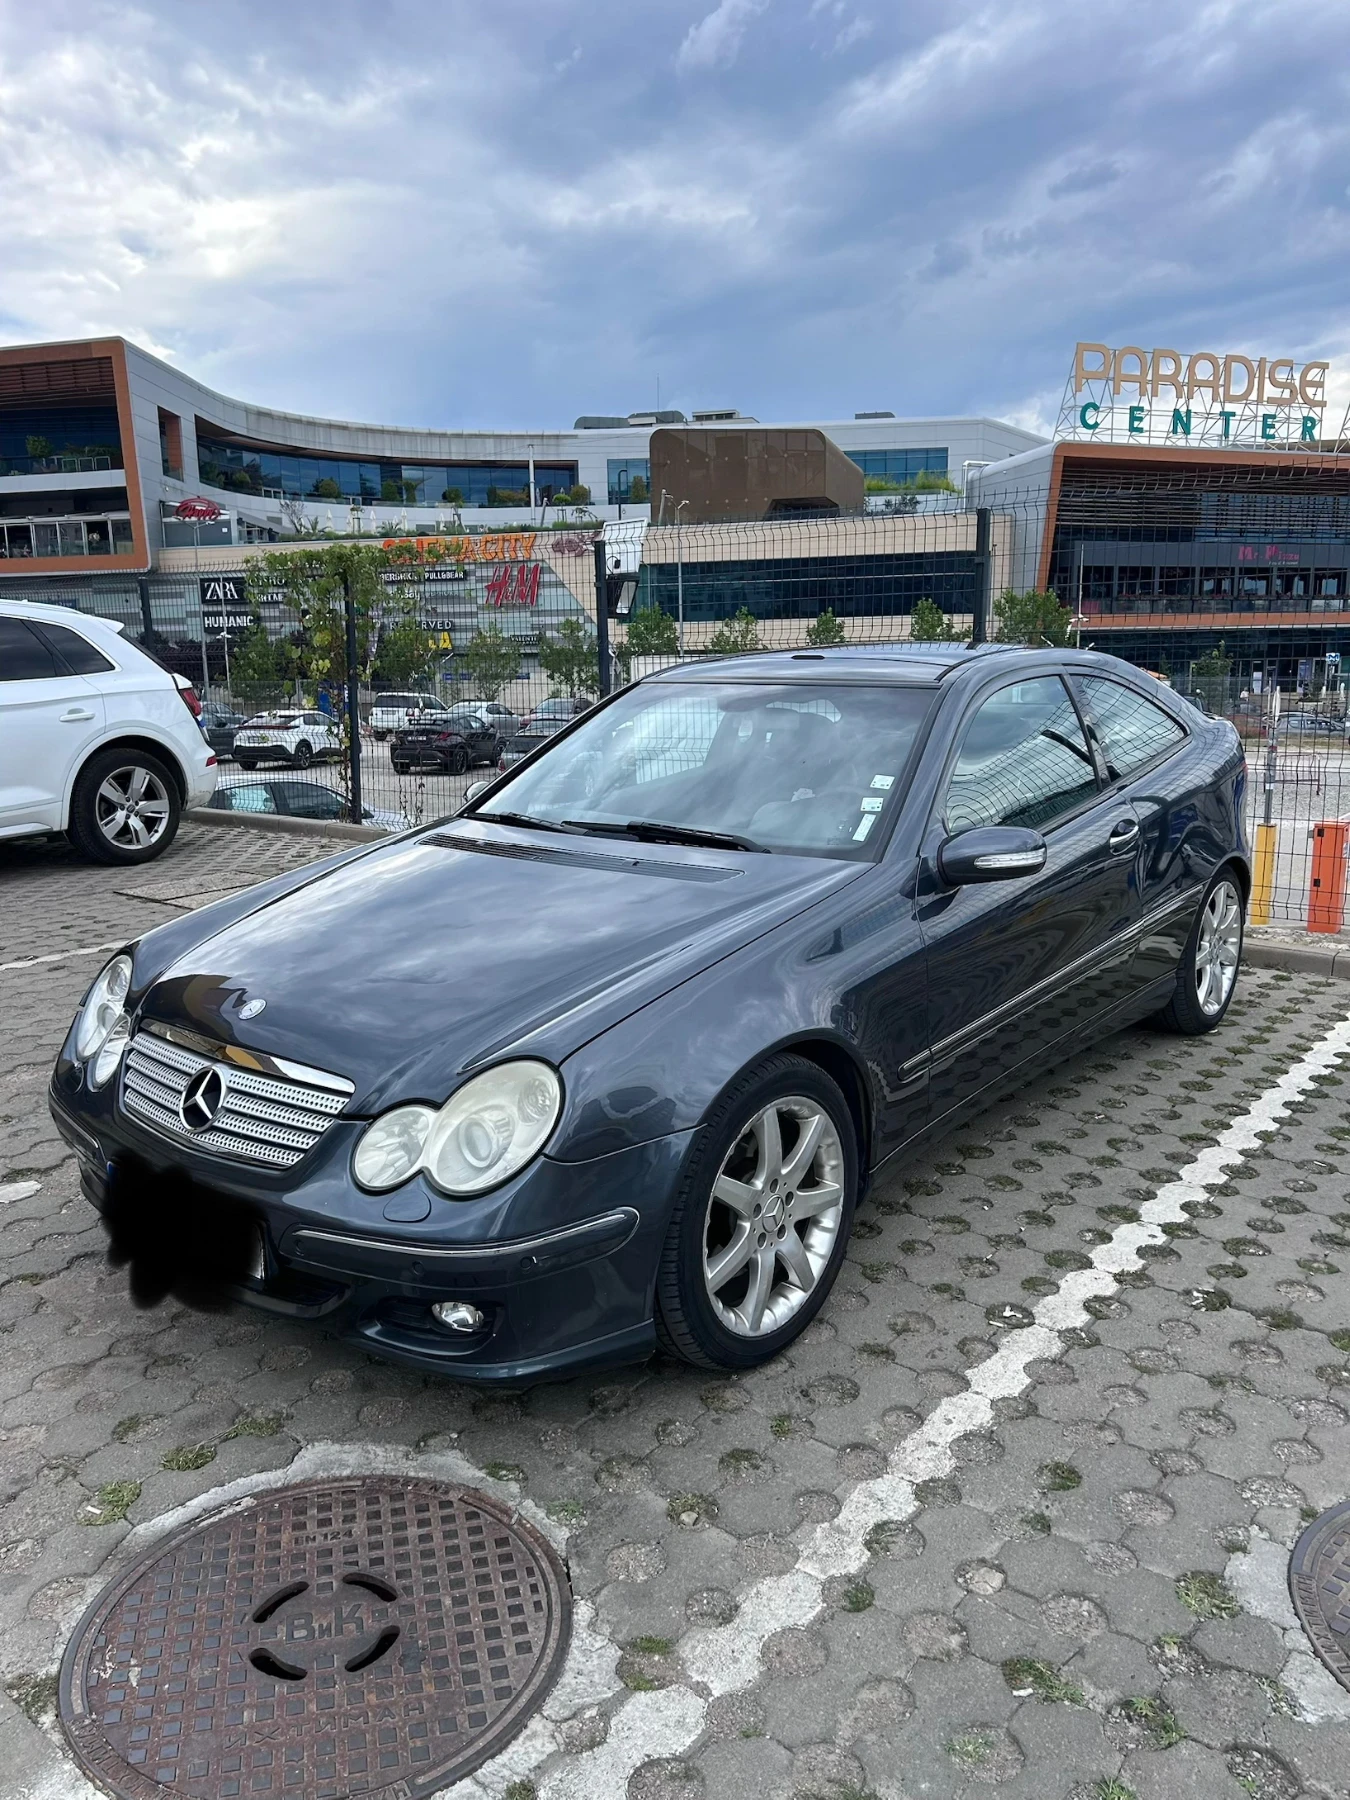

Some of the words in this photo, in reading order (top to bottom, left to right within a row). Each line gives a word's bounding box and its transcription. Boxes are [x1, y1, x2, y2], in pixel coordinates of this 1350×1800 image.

[1075, 342, 1330, 408] PARADISE
[1079, 401, 1317, 442] CENTER
[480, 533, 537, 560] CITY
[424, 571, 464, 580] PULL&BEAR
[484, 563, 540, 607] H&M
[204, 581, 239, 600] ZARA
[204, 615, 255, 628] HUMANIC
[389, 620, 452, 631] RERVED
[321, 1528, 354, 1542] 124
[284, 1603, 365, 1645] ВиК
[224, 1701, 425, 1750] ИХТИМАН
